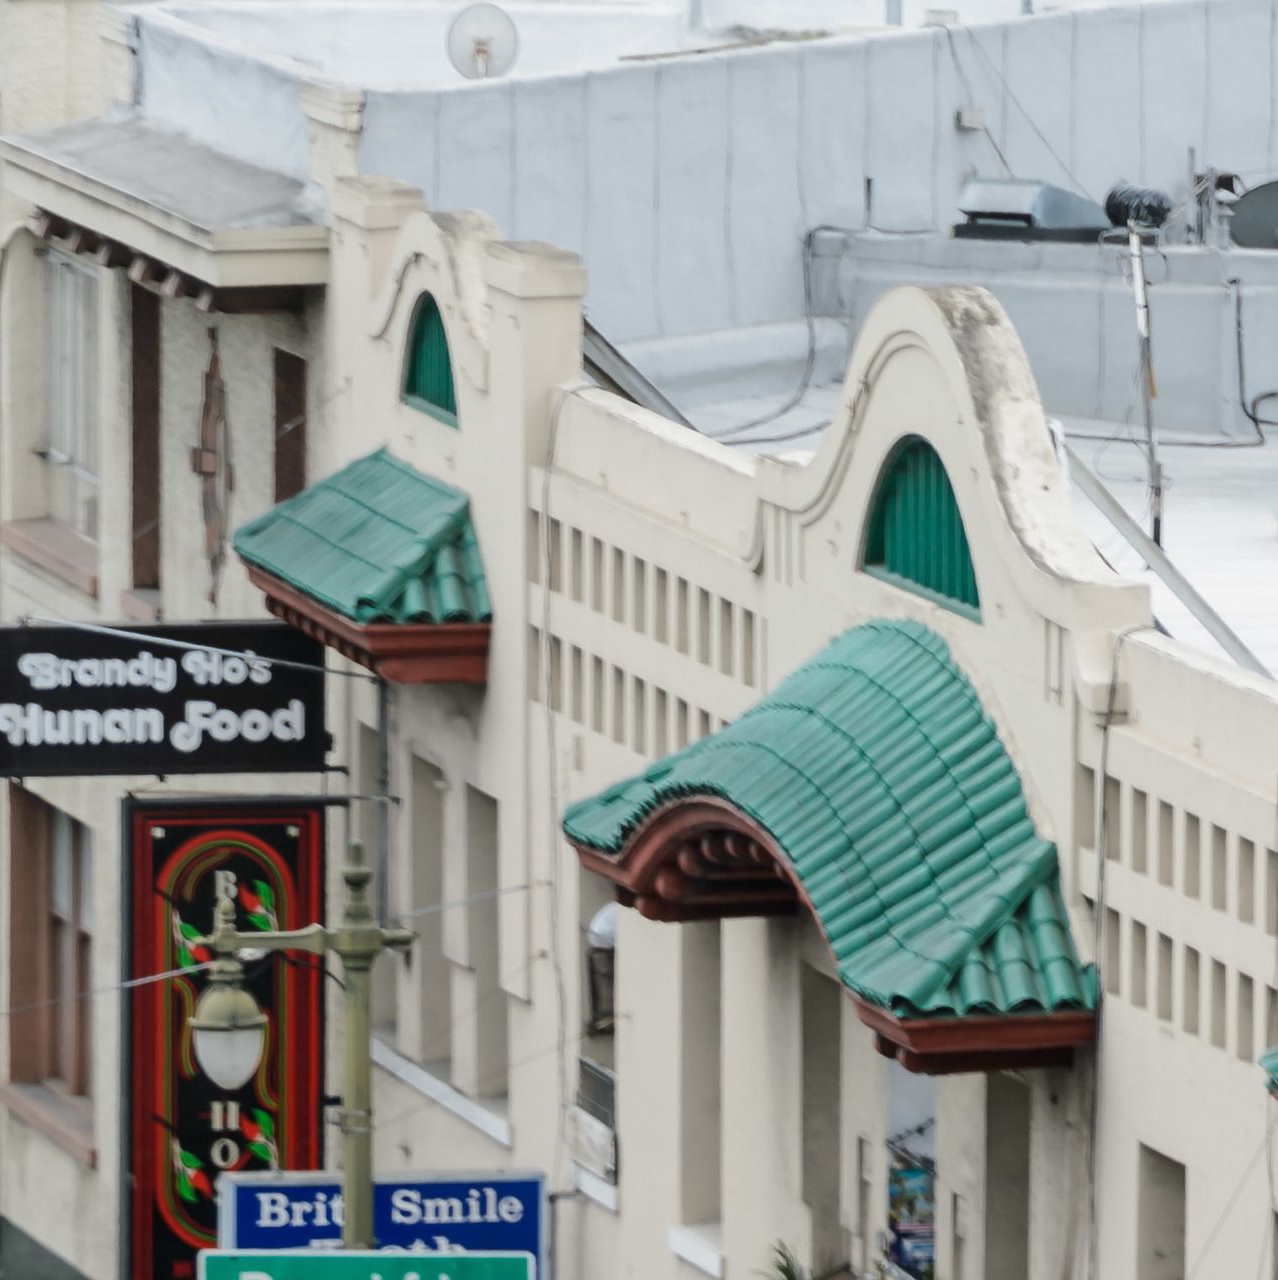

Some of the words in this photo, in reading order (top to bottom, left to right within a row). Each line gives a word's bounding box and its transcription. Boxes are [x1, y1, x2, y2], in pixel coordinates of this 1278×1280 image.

[18, 651, 177, 692] Brandy
[182, 649, 272, 685] Ho's
[170, 699, 306, 752] Food
[391, 1188, 524, 1224] Smile
